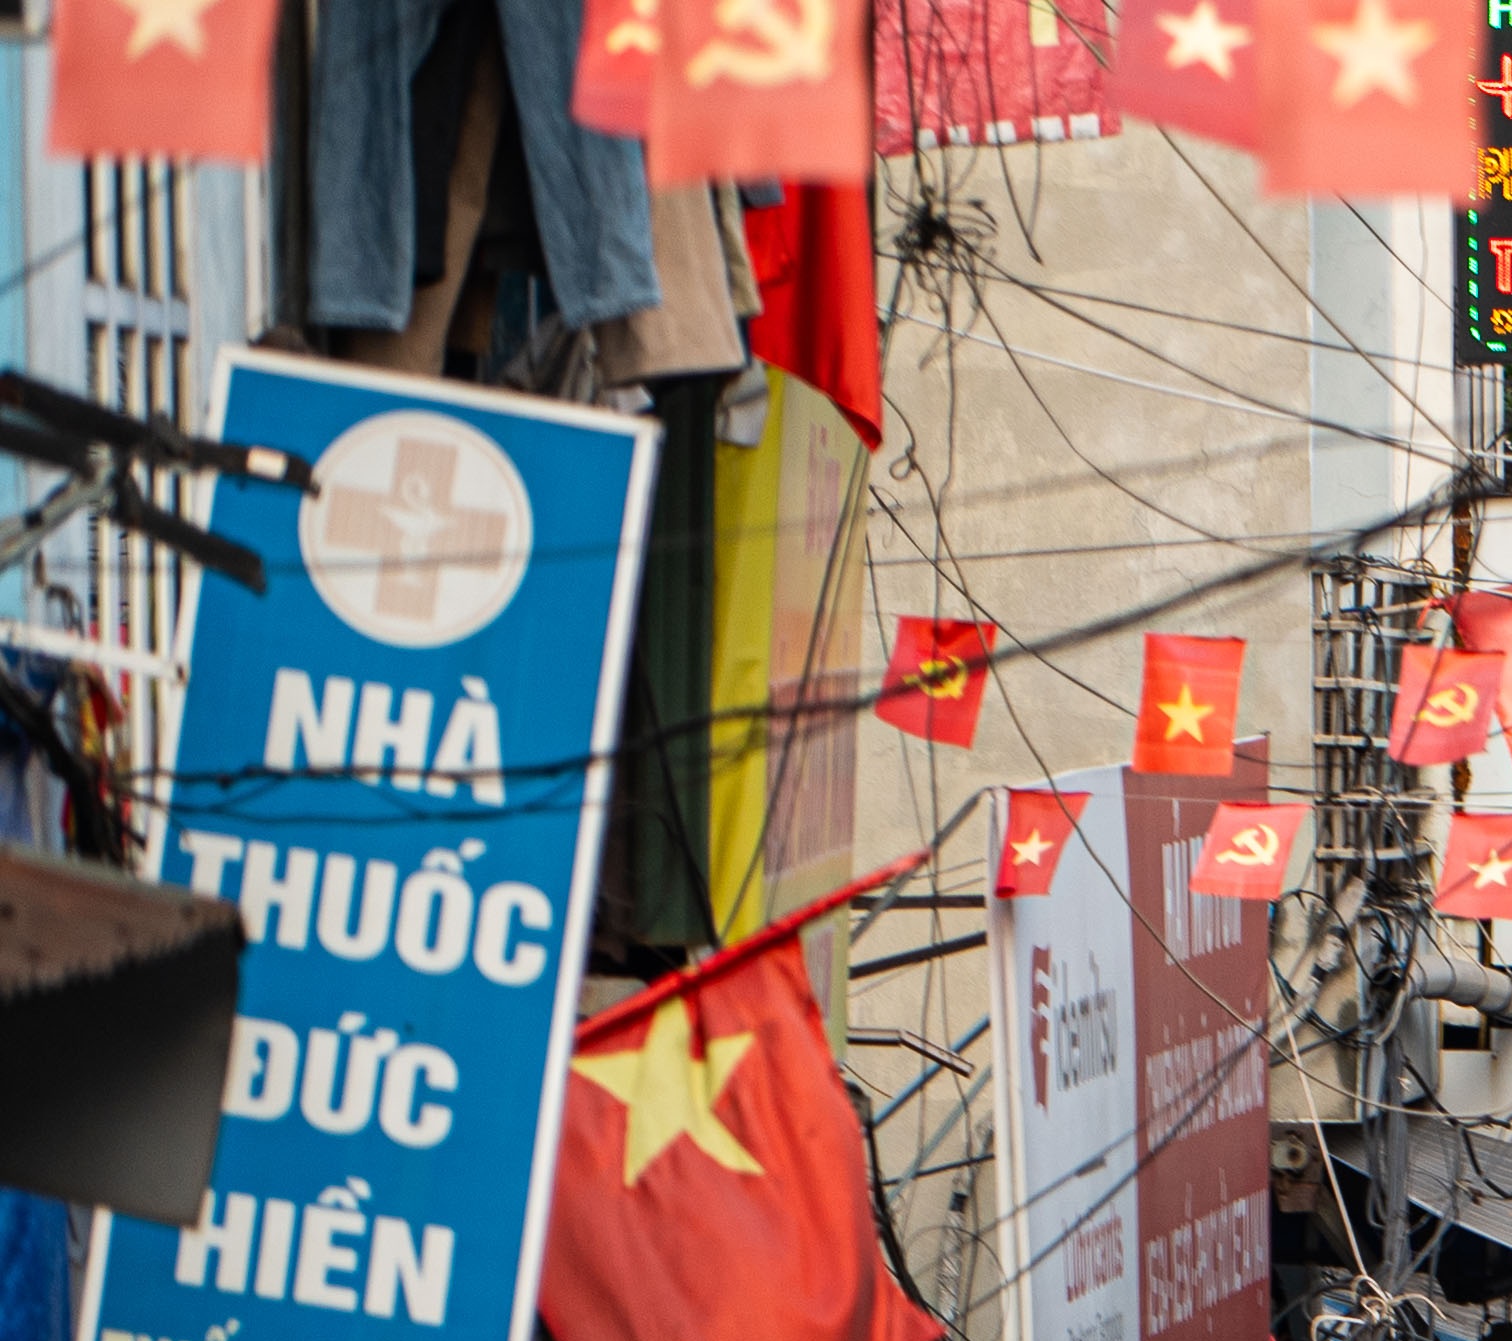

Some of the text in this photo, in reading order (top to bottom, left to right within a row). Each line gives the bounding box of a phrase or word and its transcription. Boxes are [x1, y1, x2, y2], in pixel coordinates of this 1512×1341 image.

[263, 668, 507, 808] NHÀ
[179, 831, 554, 988] THUỐC
[222, 1012, 460, 1149] ĐỨC
[1053, 950, 1118, 1092] idemitsu
[174, 1177, 457, 1326] HIỀN
